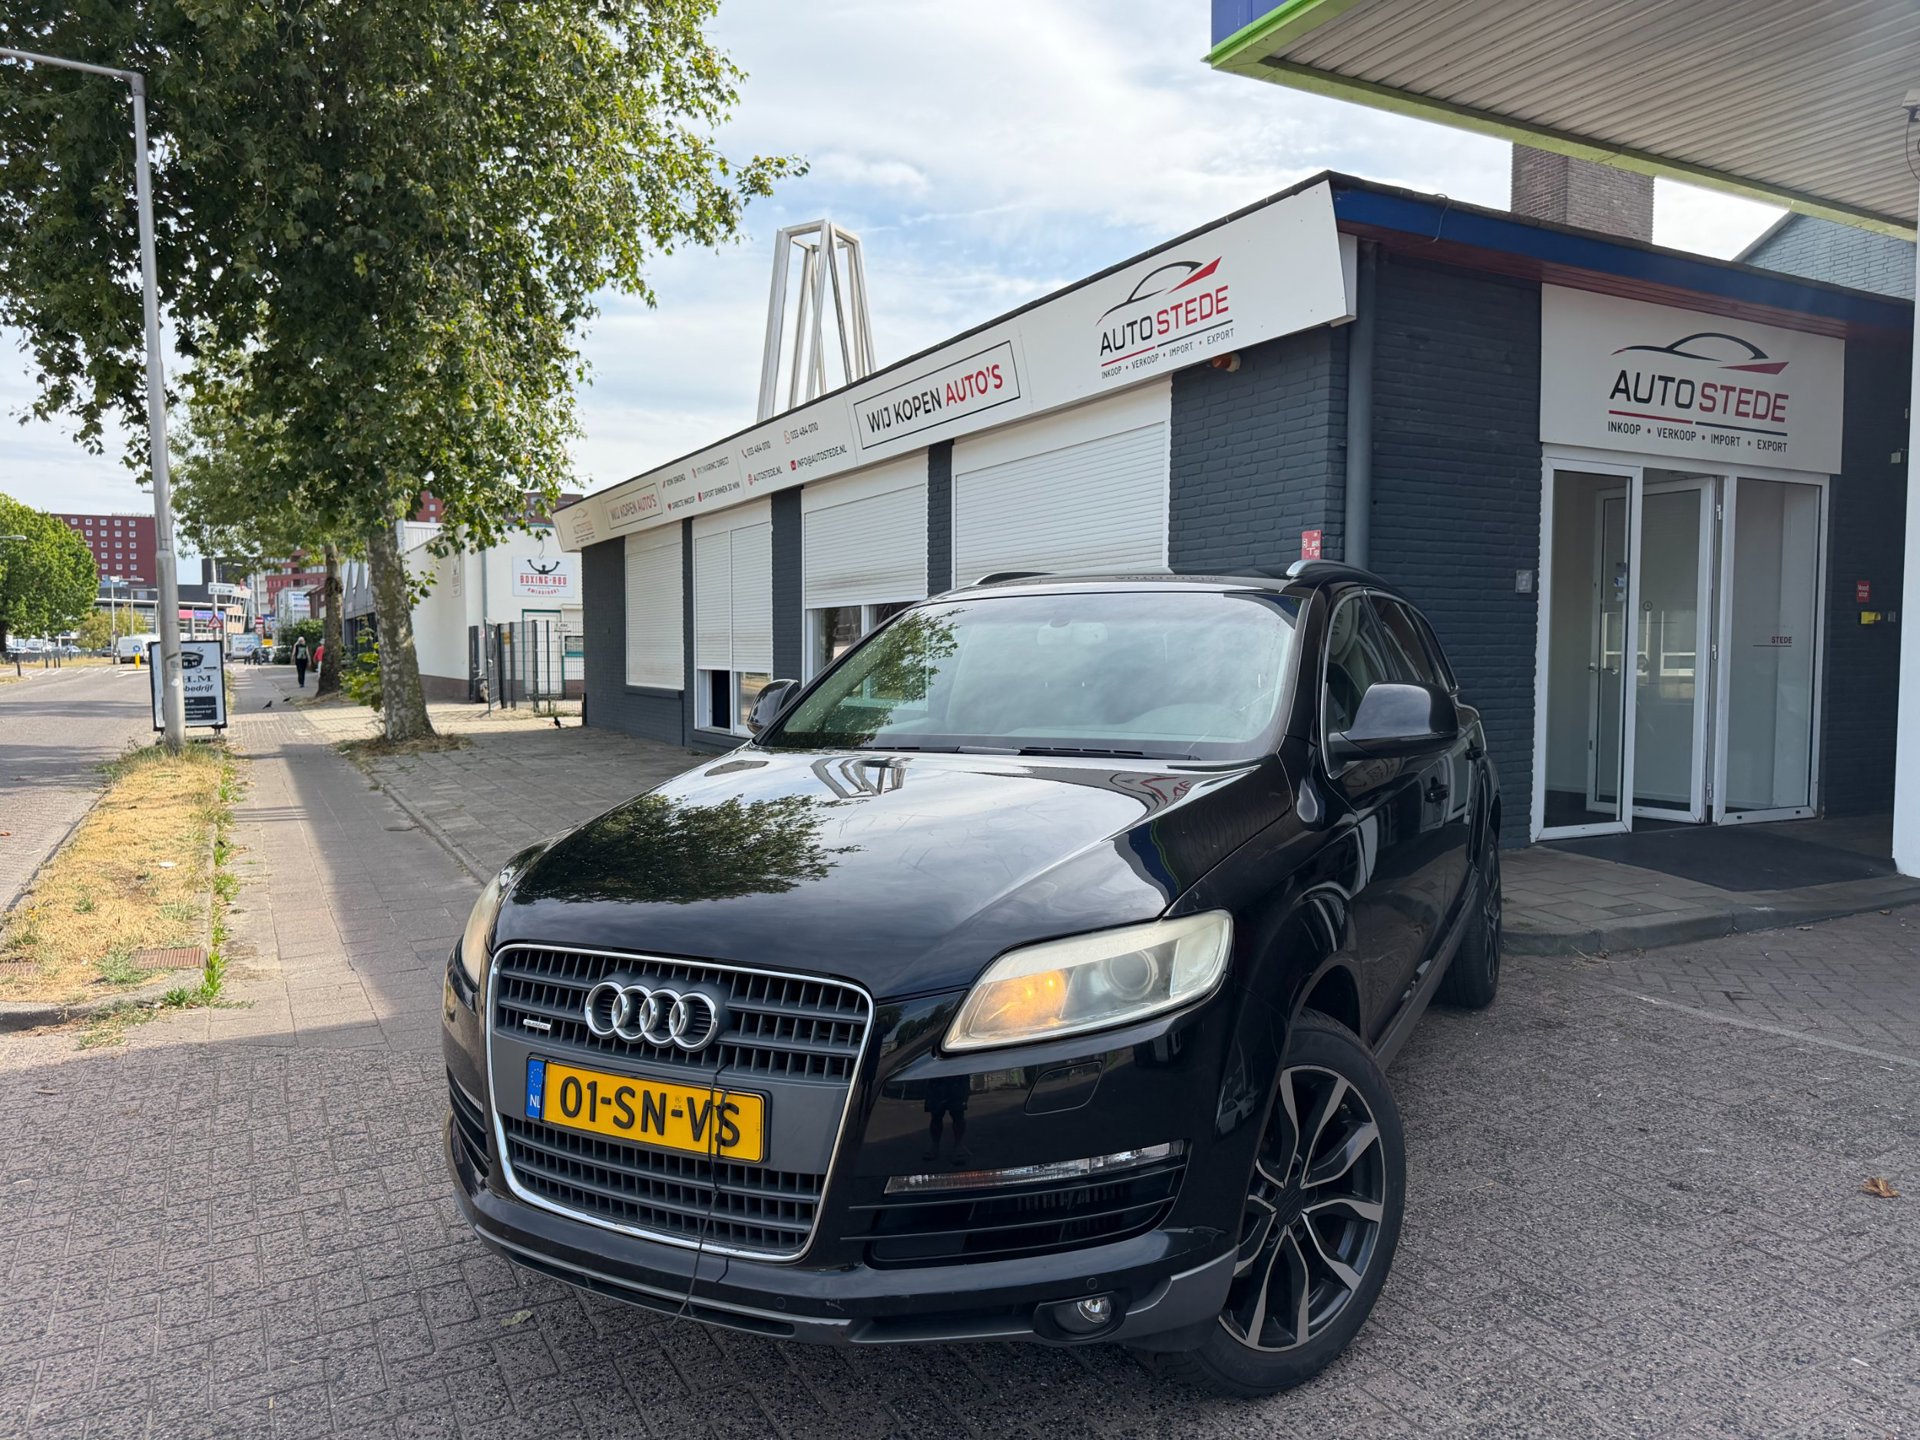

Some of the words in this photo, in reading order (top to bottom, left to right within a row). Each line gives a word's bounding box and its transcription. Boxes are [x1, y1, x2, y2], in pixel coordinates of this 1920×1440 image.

[1101, 365, 1122, 380] INKOOP
[1131, 353, 1160, 370] VERKOOP
[1169, 341, 1194, 358] IMPORT
[1206, 327, 1235, 346] EXPORT
[866, 407, 892, 433] WIJ
[895, 387, 943, 425] KOPEN
[945, 363, 1003, 407] AUTO'S
[1607, 421, 1641, 435] INKOOP
[1656, 427, 1697, 442] VERKOOP
[1710, 434, 1741, 447] IMPORT
[1757, 439, 1788, 453] EXPORT
[520, 575, 549, 585] BOXING
[184, 684, 214, 692] bedrijf
[529, 1094, 541, 1108] NL
[560, 1076, 741, 1148] 01-SN-VS
